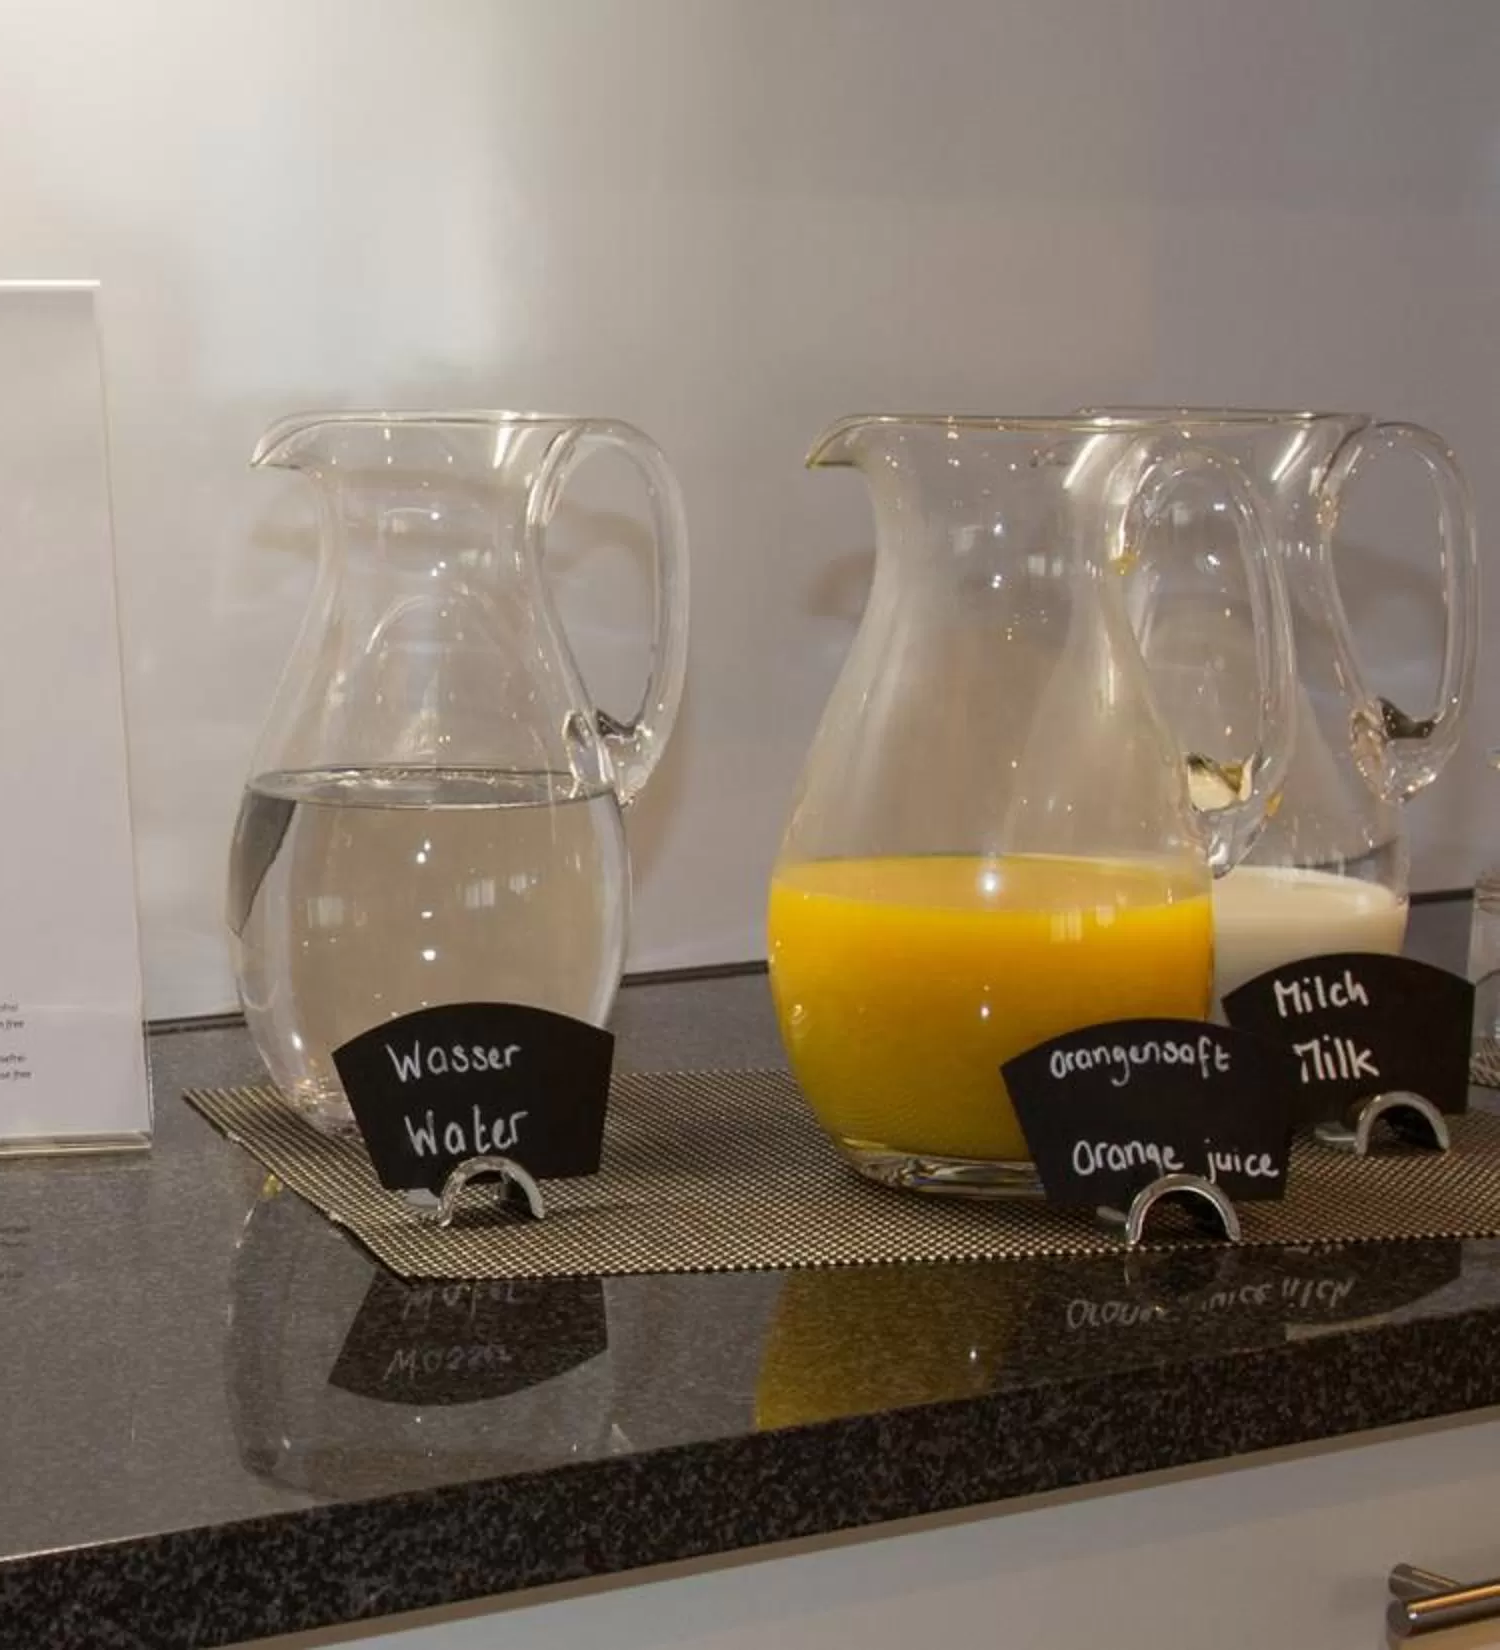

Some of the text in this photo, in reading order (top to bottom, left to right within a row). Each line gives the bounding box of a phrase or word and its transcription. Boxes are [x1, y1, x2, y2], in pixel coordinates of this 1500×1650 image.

[1273, 969, 1369, 1019] Milch
[385, 1039, 521, 1083] Wasser
[1292, 1034, 1380, 1084] Milk
[404, 1103, 529, 1157] Water
[1072, 1137, 1280, 1183] Orange juice
